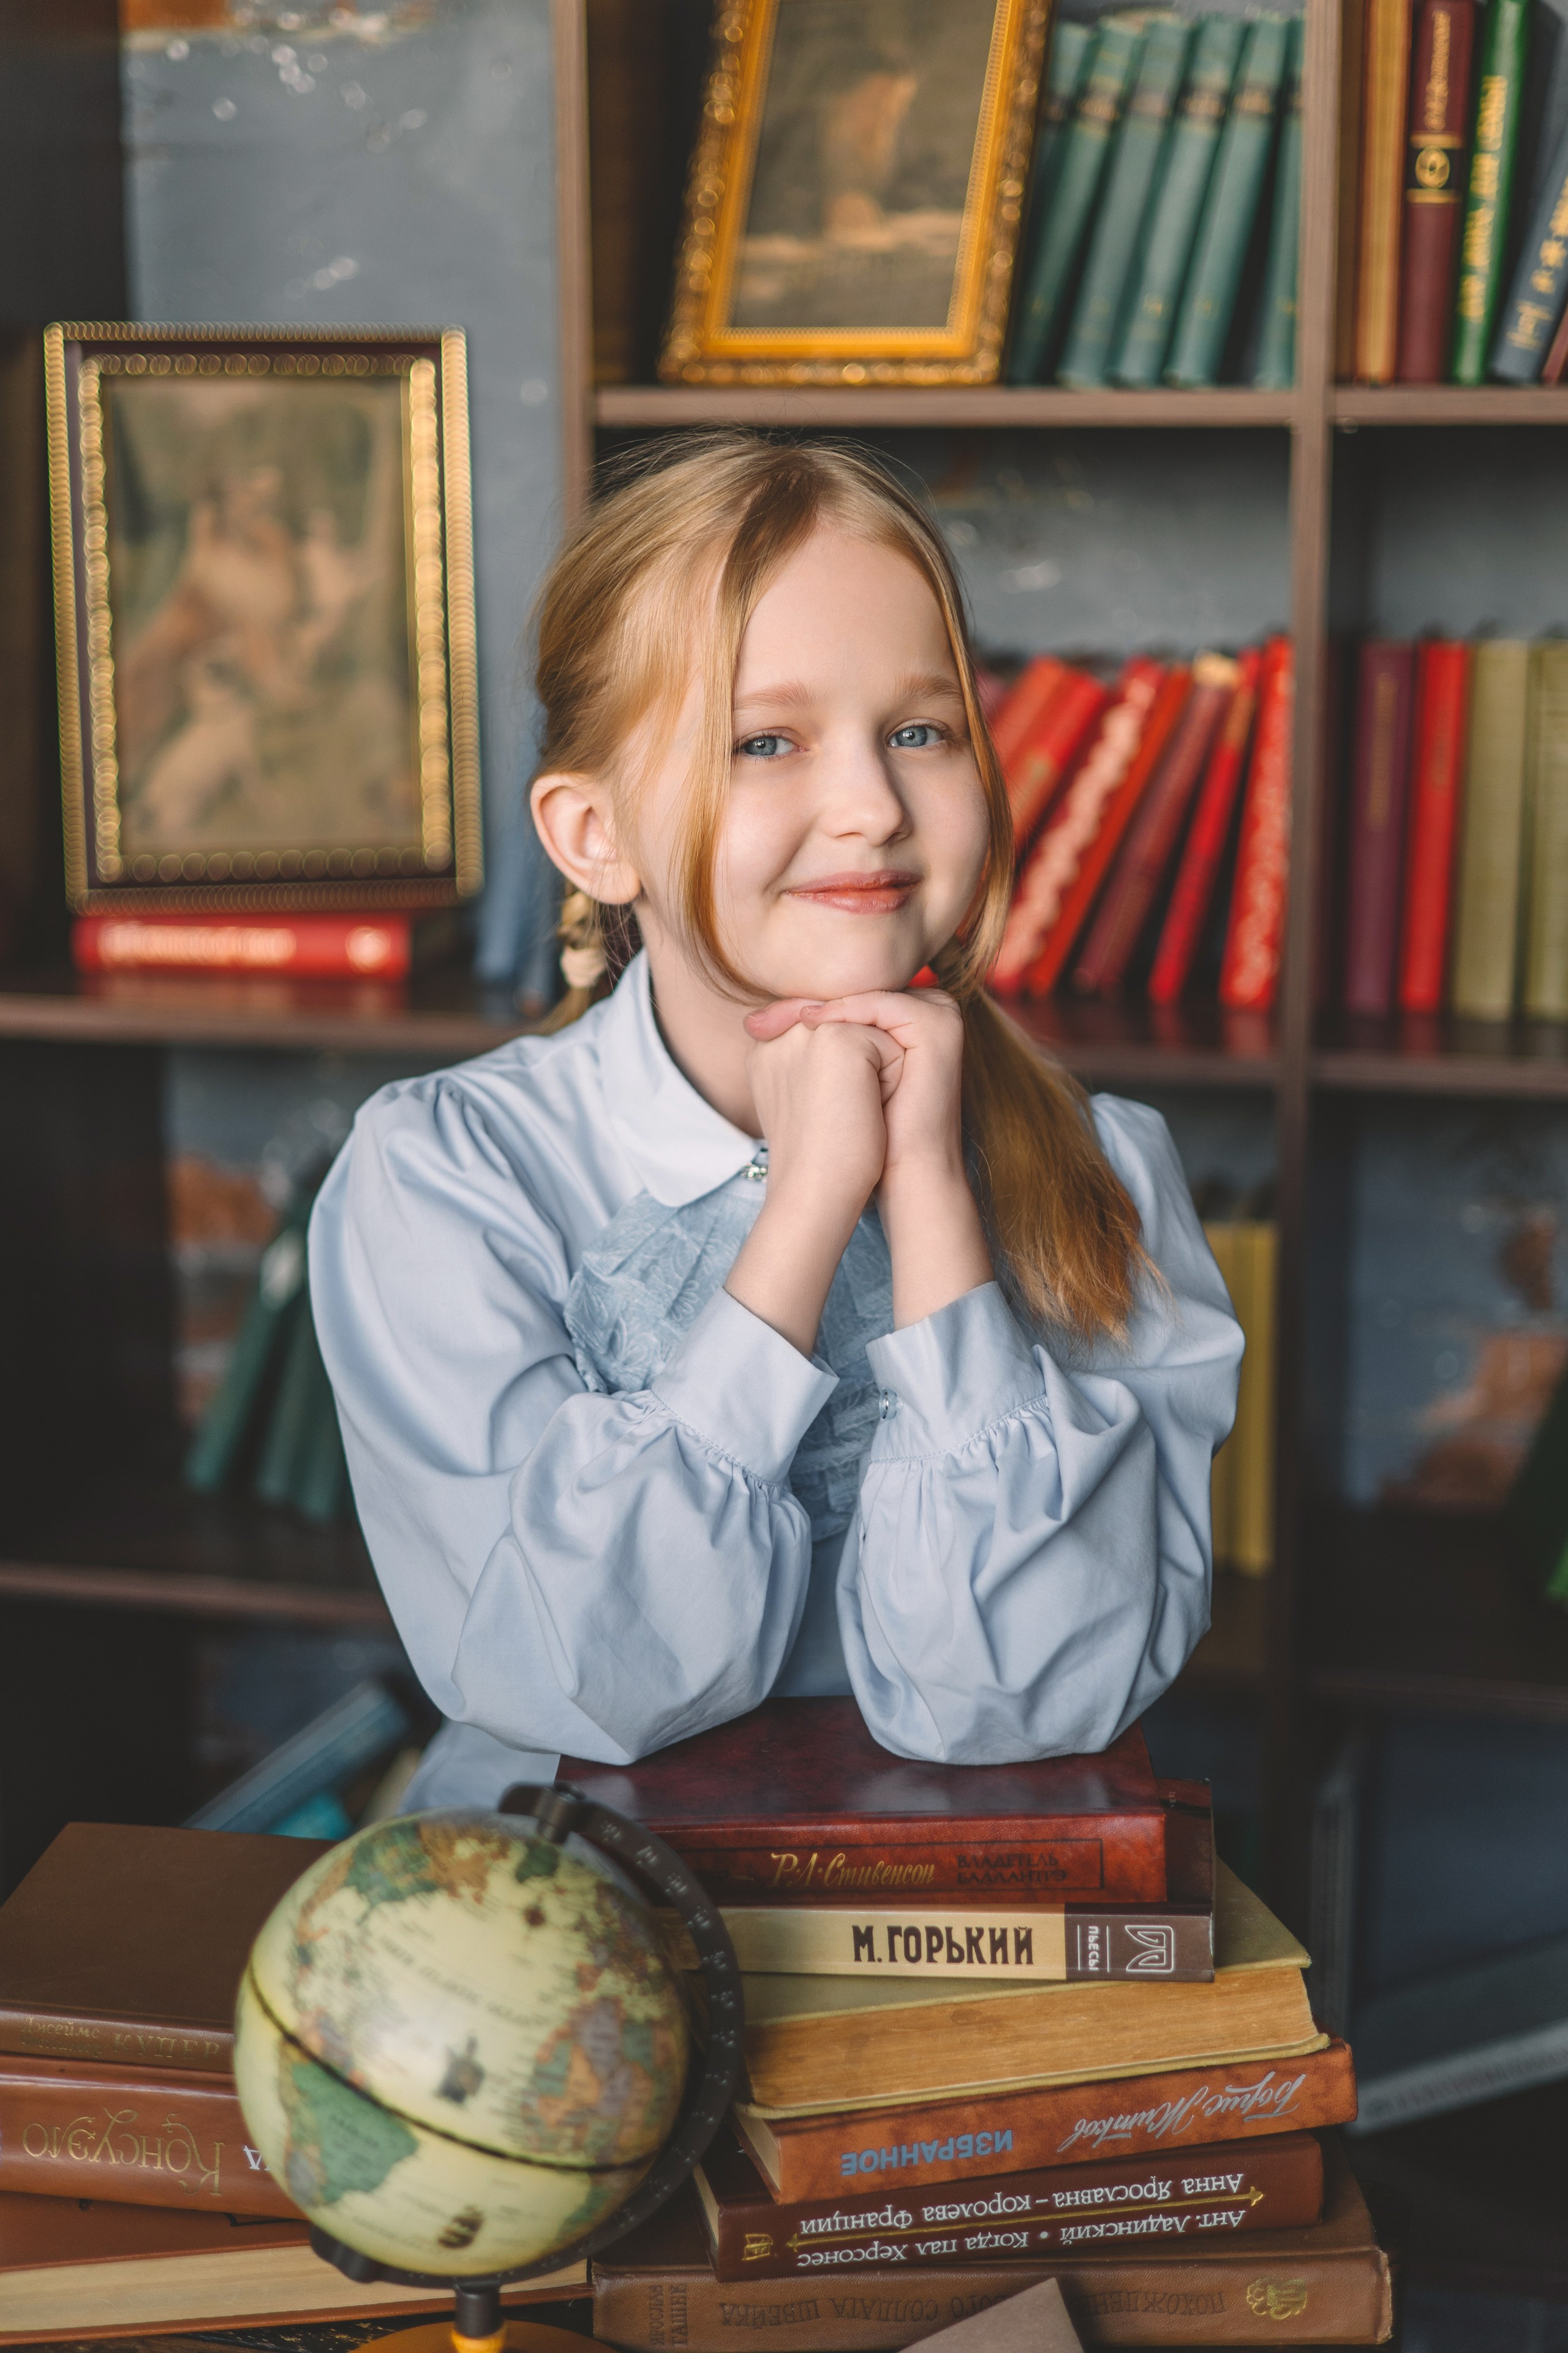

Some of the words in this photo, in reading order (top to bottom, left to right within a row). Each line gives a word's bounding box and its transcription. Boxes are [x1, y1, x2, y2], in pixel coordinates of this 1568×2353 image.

[823, 1853, 935, 1886] Стивенсон
[956, 1853, 1059, 1868] ВЛАДЕТЕЛЬ
[956, 1868, 1067, 1884] БАЛЛАНТРЭ
[1088, 1925, 1099, 1971] ПЬЕСЫ
[112, 2031, 221, 2060] КУПЕР
[1202, 2071, 1306, 2123] Борис
[1057, 2085, 1208, 2153] Житков
[841, 2128, 1014, 2176] ИЗБРАННОЕ
[1052, 2175, 1172, 2208] Ярославна
[1181, 2174, 1245, 2194] Анна
[801, 2204, 913, 2235] Франции
[922, 2192, 1032, 2222] королева
[1194, 2210, 1246, 2228] Ант.
[964, 2231, 1030, 2248] Когда
[1060, 2213, 1191, 2245] Ладинский
[797, 2240, 908, 2267] Херсонес
[915, 2238, 957, 2256] пал
[718, 2297, 821, 2330] ШВЕЙКА
[829, 2297, 939, 2323] СОЛДАТА
